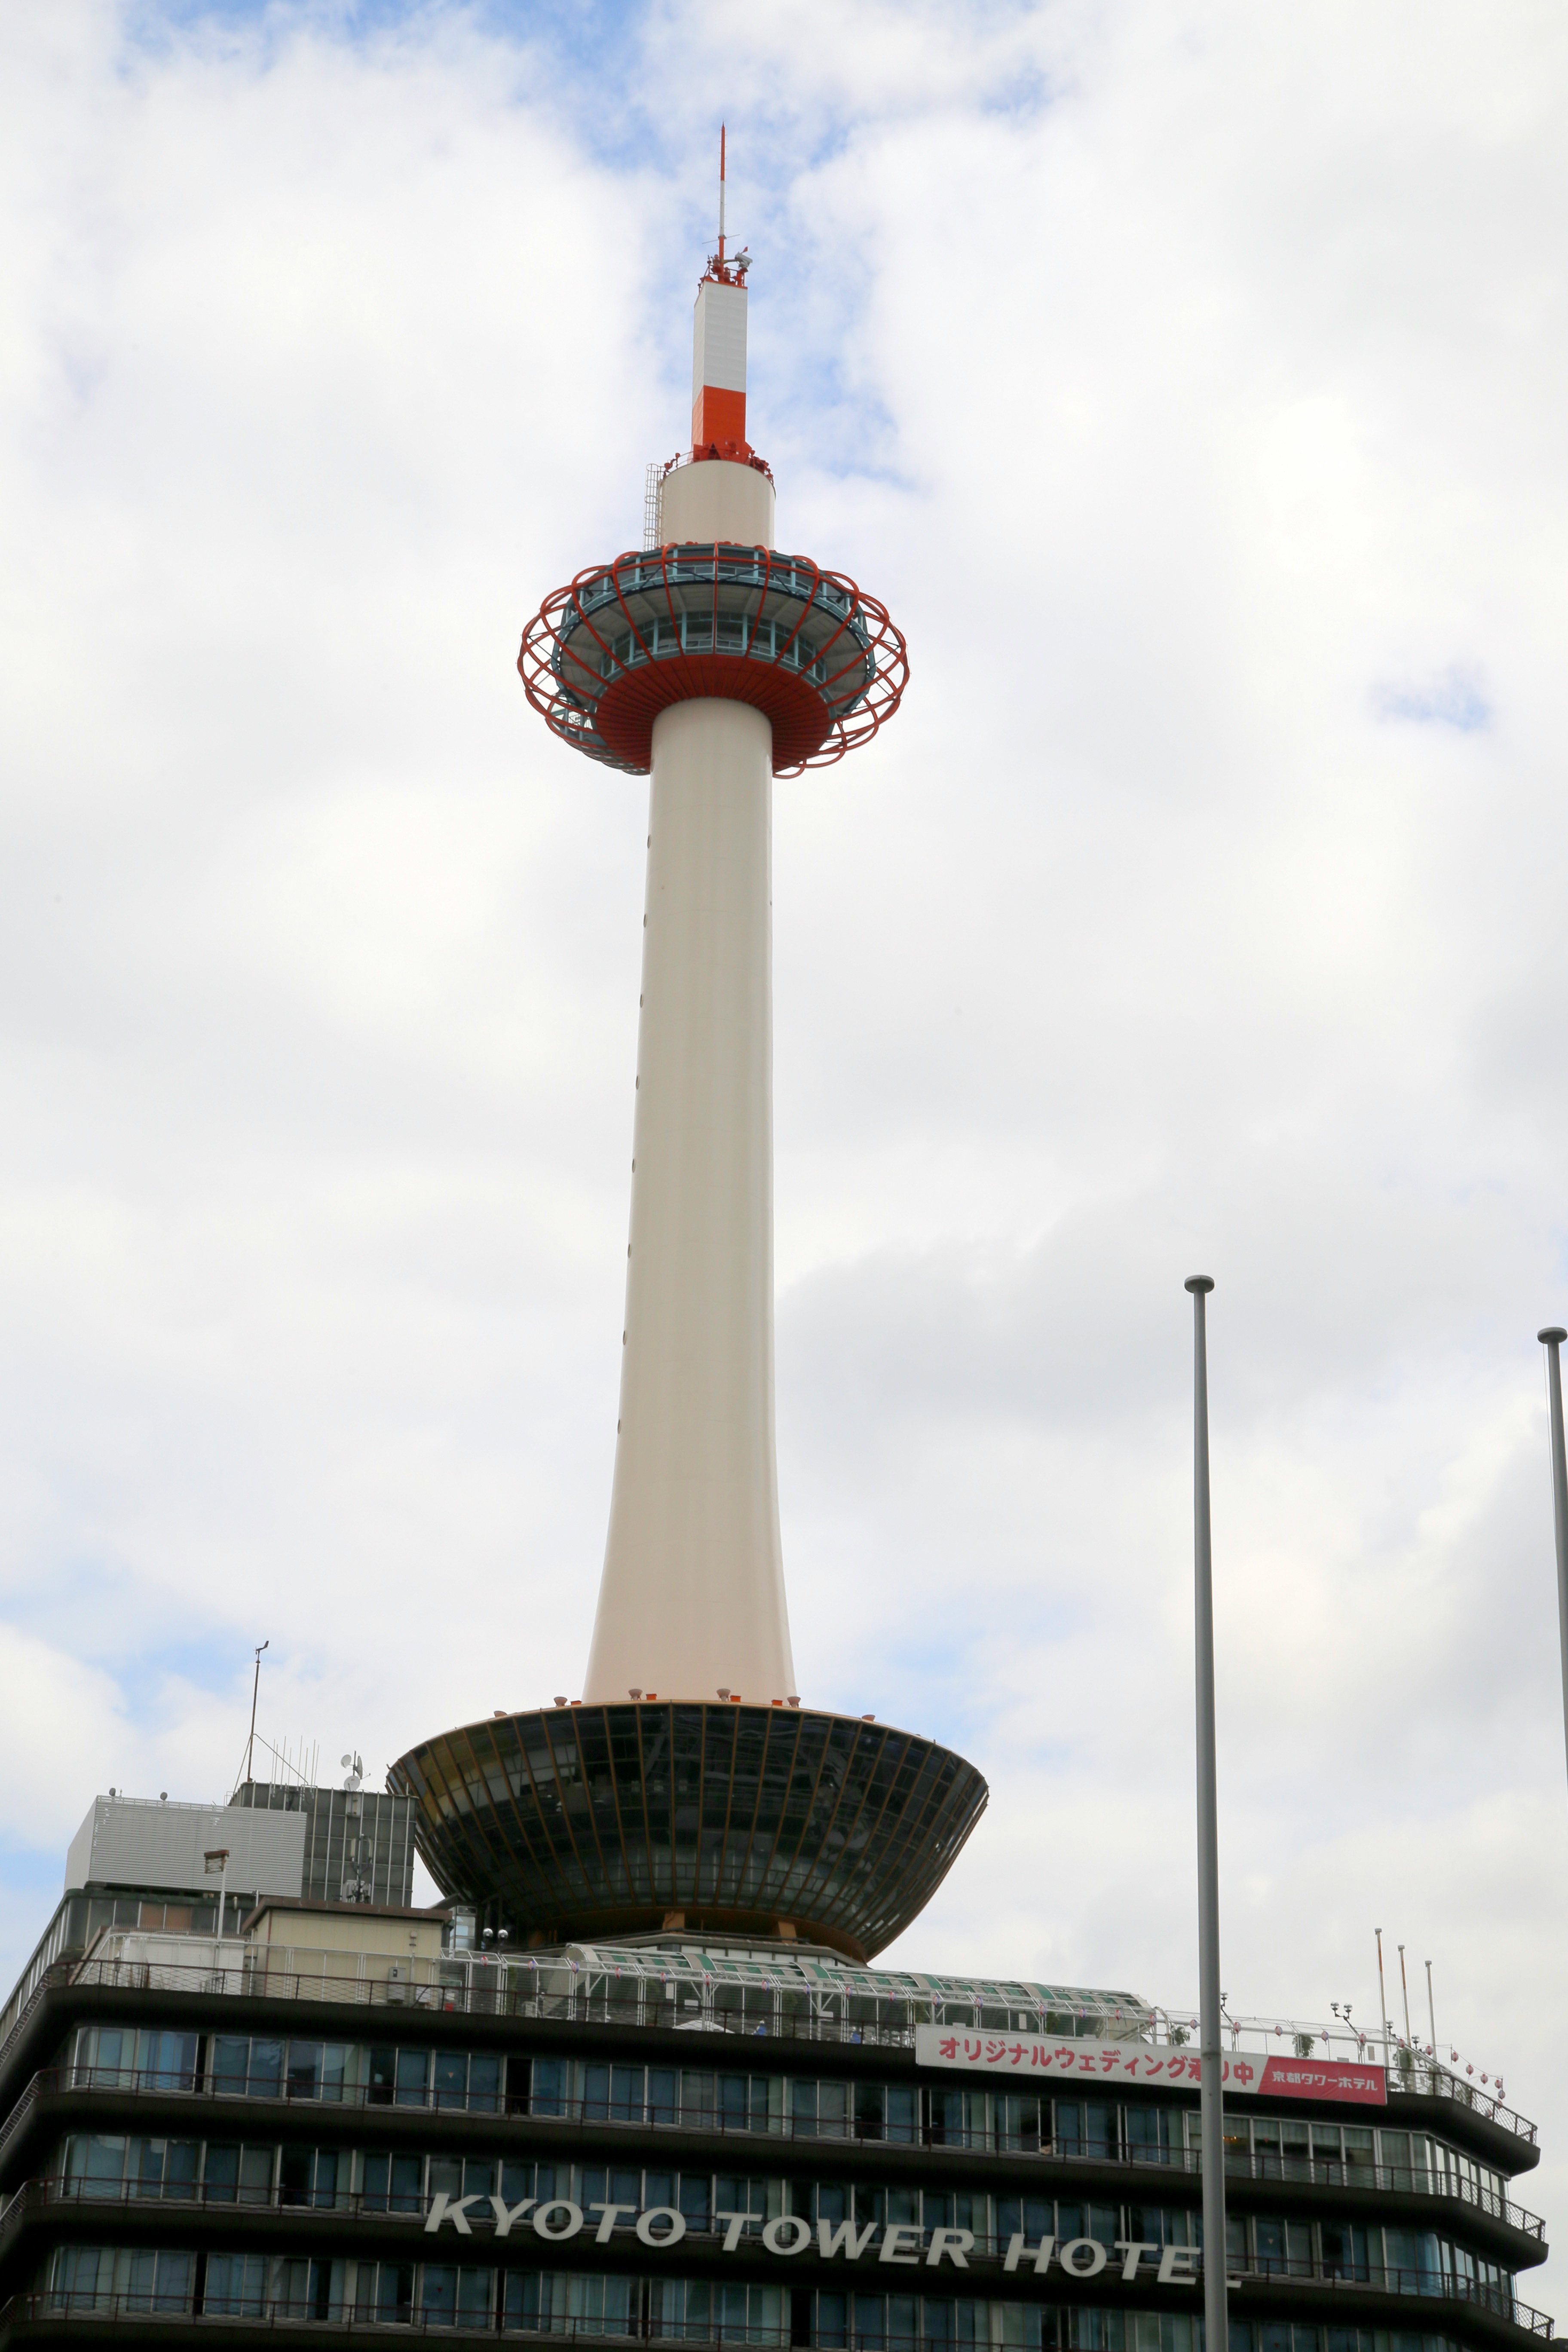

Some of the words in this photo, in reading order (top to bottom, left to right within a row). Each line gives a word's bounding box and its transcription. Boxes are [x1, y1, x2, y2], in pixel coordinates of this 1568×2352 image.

[1272, 2071, 1378, 2091] 京都タワーホテル
[424, 2193, 686, 2247] KYOTO
[716, 2211, 975, 2268] TOWER
[1003, 2233, 1242, 2288] HOTE
